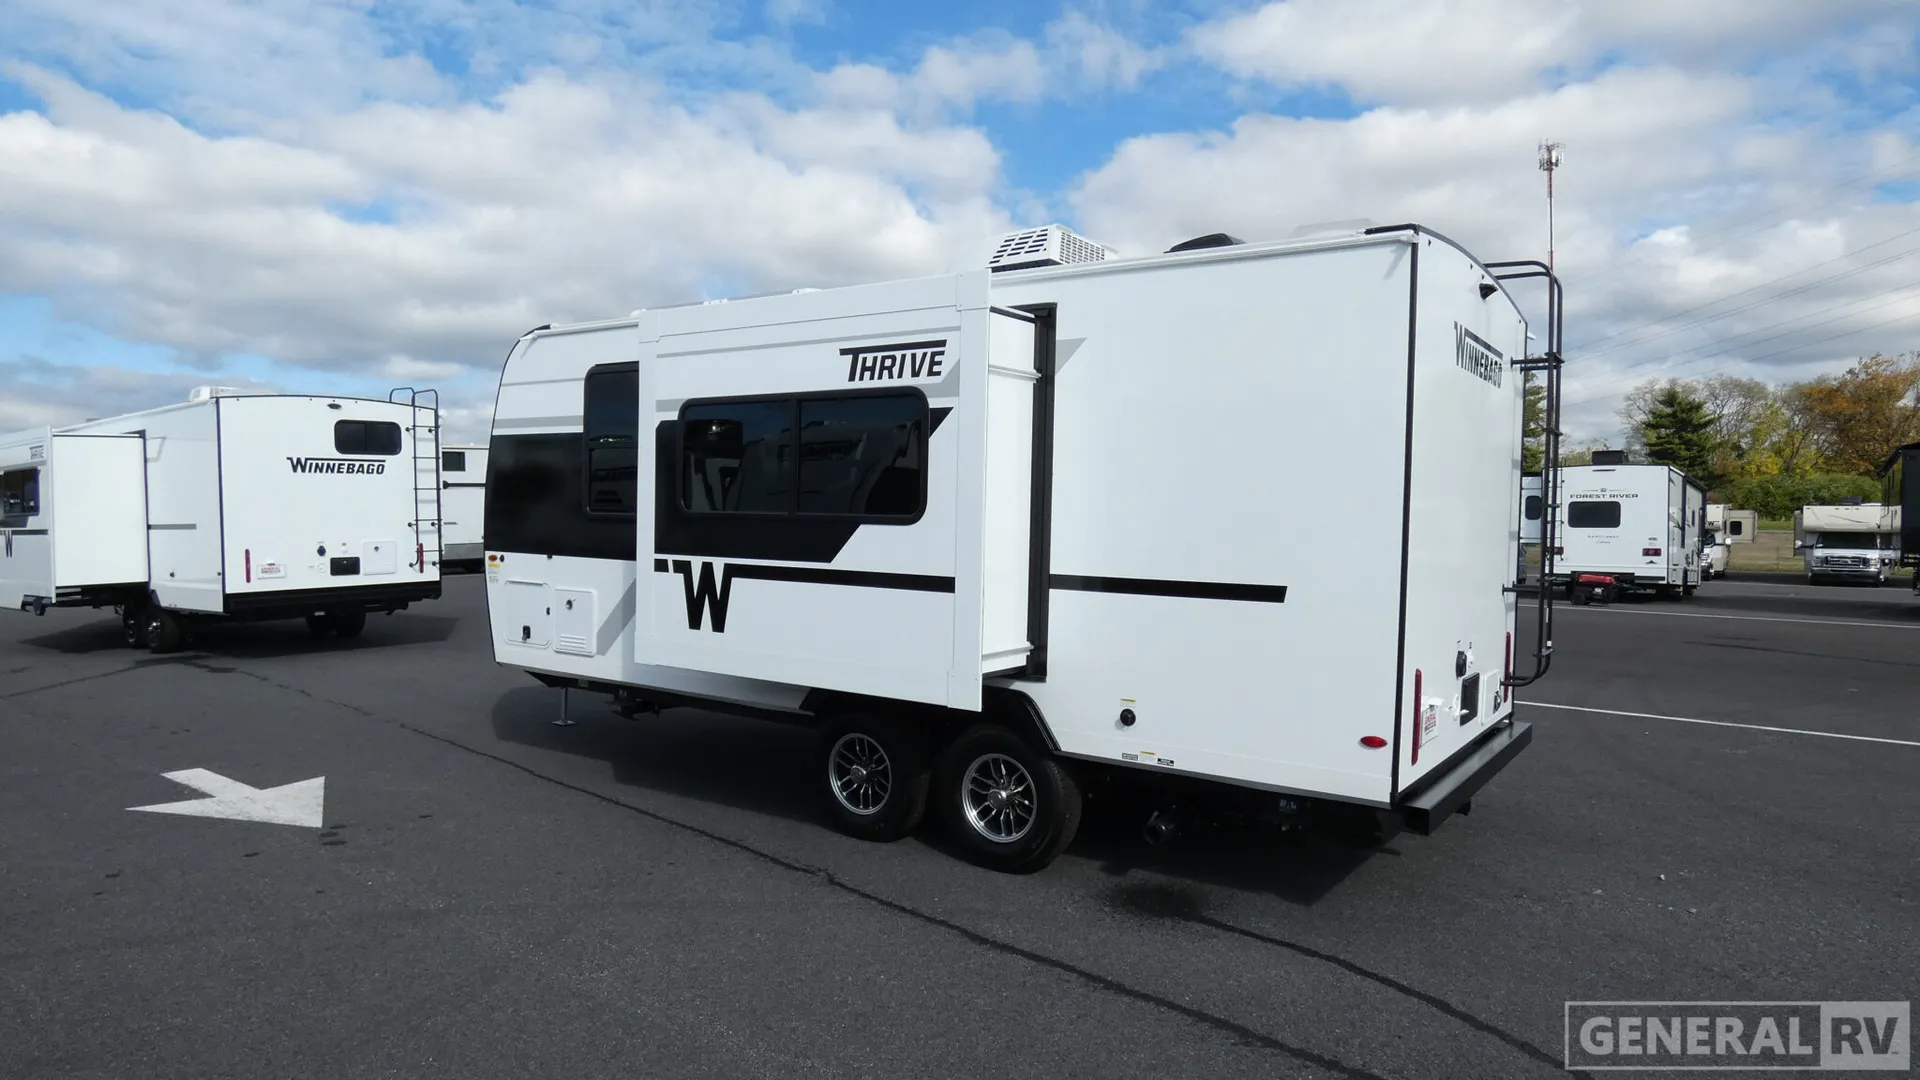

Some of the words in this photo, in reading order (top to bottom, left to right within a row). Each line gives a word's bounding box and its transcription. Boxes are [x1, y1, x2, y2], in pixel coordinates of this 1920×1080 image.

[839, 339, 948, 382] THRIVE
[1453, 320, 1503, 389] WINNEBAGO
[286, 457, 387, 475] WINNEBAGO
[672, 559, 733, 634] W
